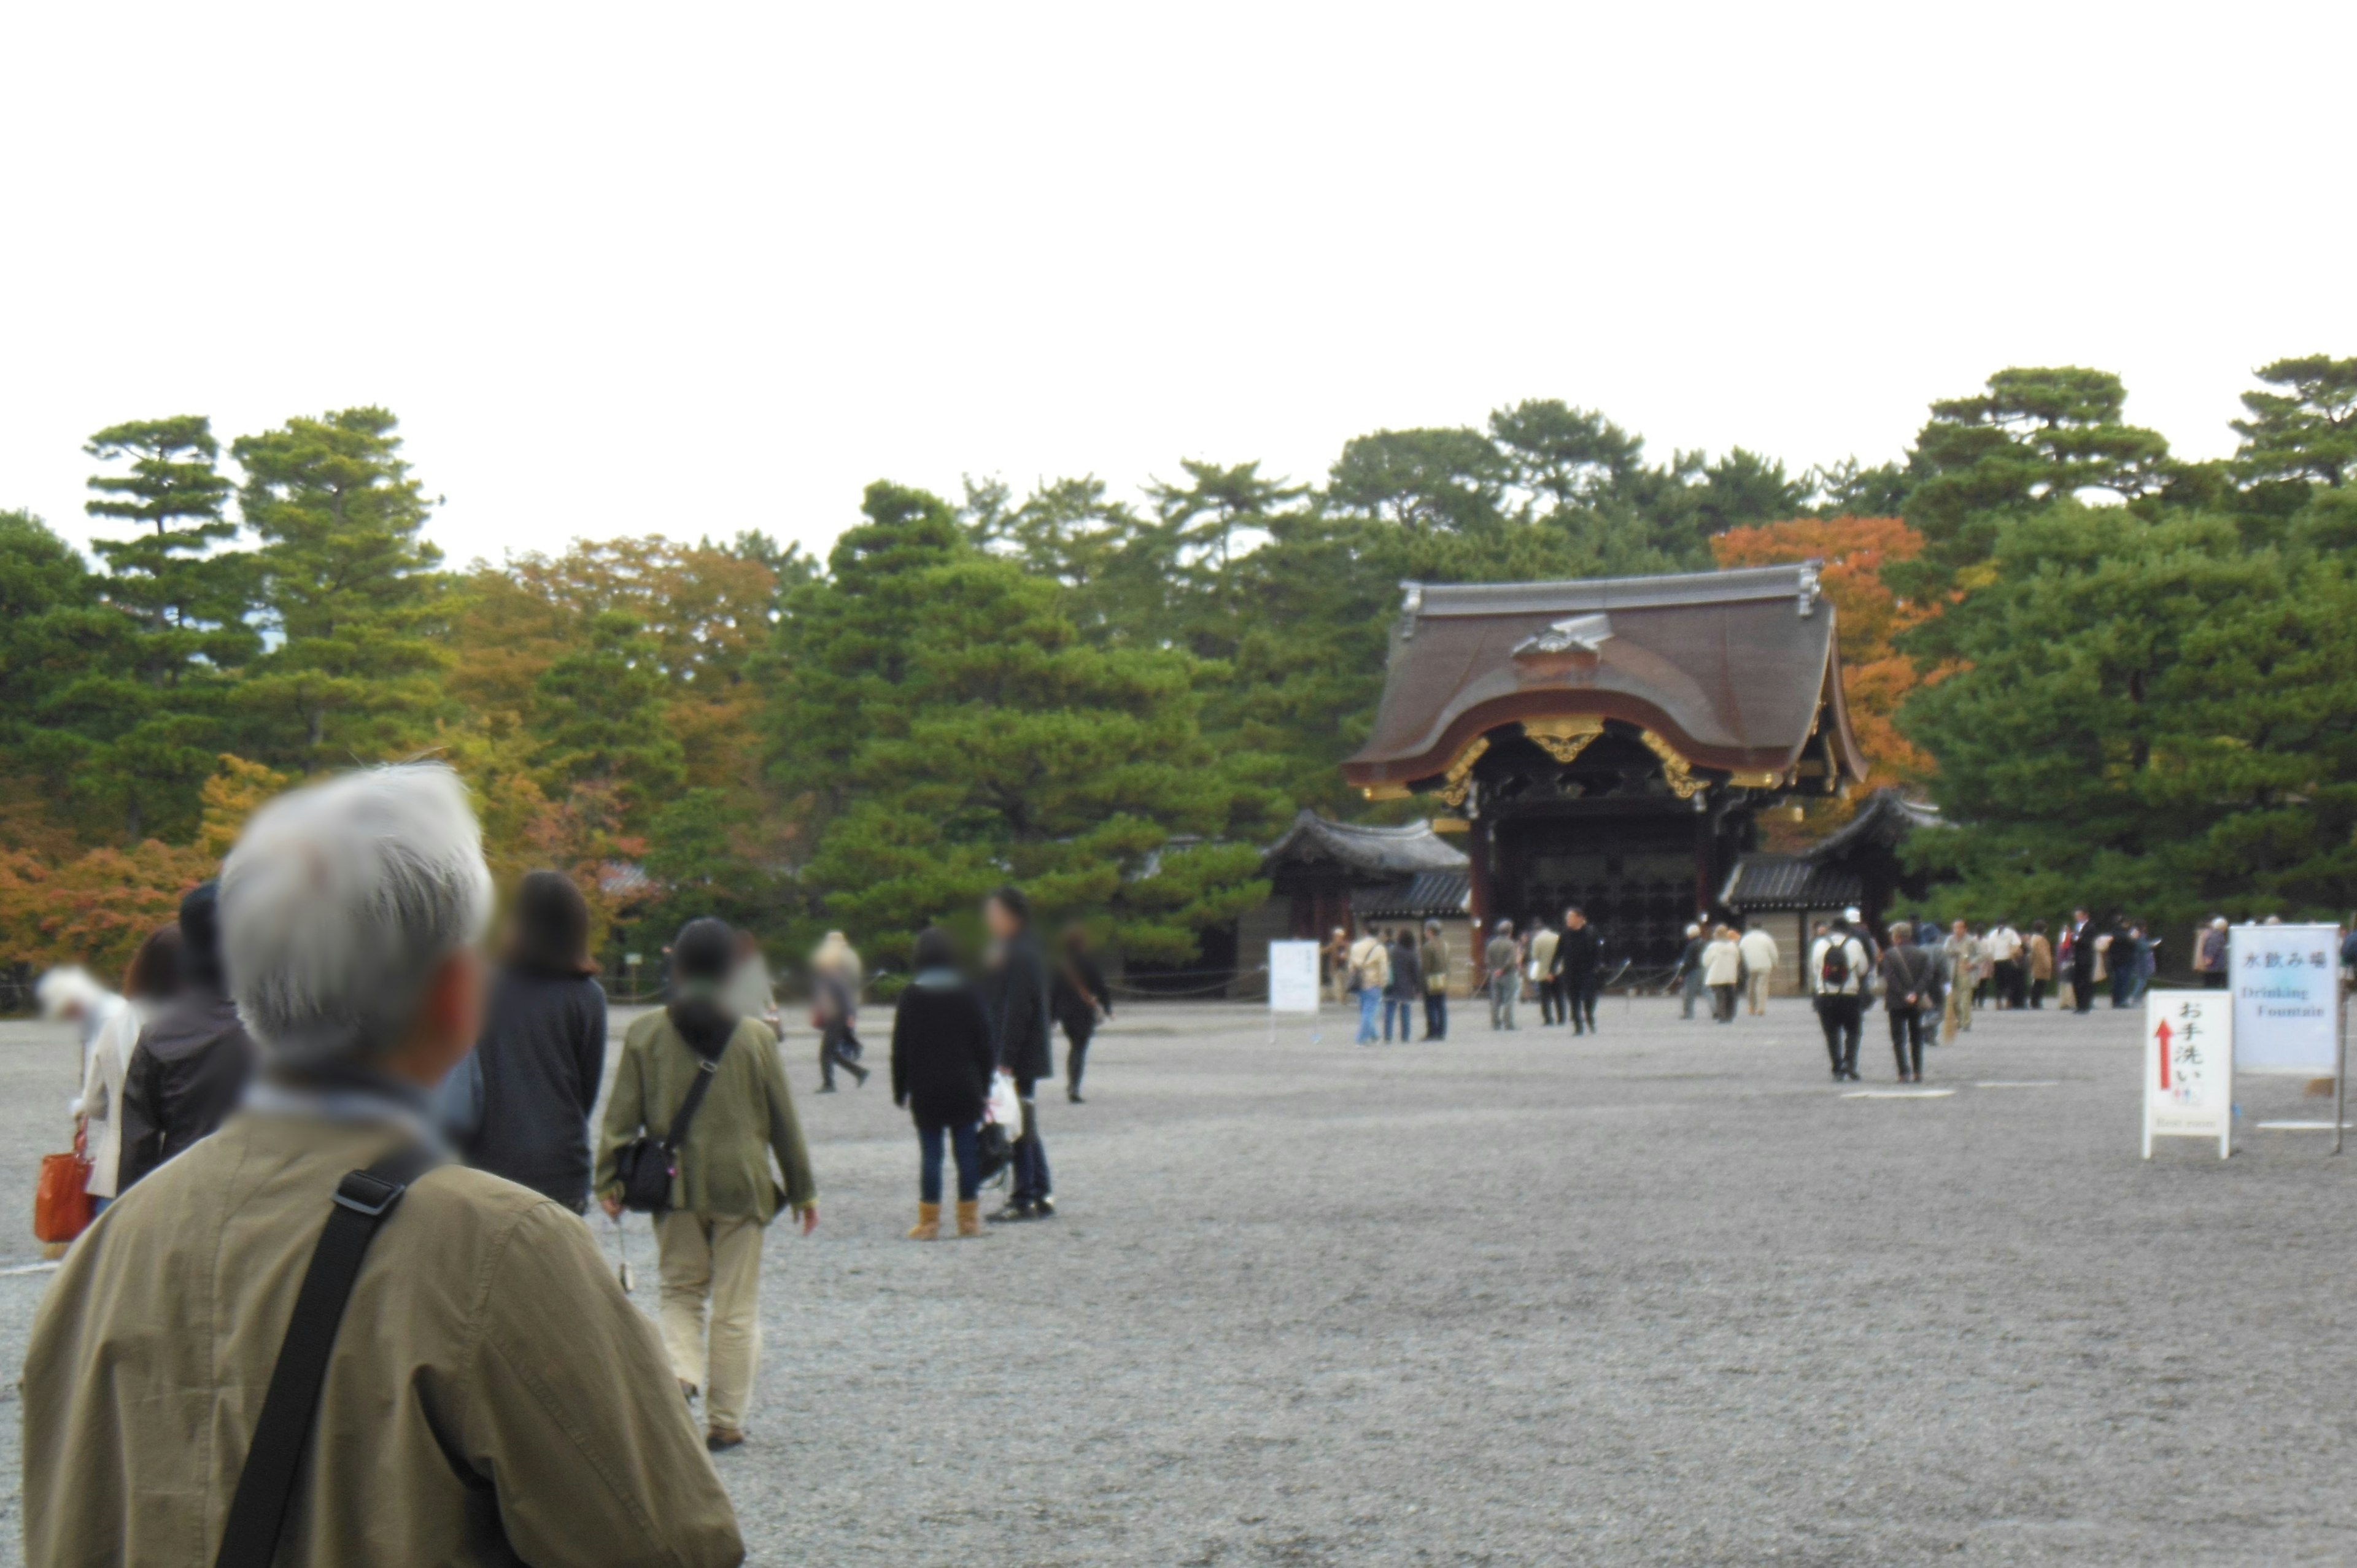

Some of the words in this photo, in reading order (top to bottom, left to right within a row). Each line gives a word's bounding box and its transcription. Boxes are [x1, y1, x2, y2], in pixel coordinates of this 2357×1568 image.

[2242, 951, 2327, 968] 水飲み場
[2242, 987, 2309, 1000] Drinking
[2258, 1005, 2324, 1017] Fountain
[2174, 1002, 2204, 1082] お手洗い
